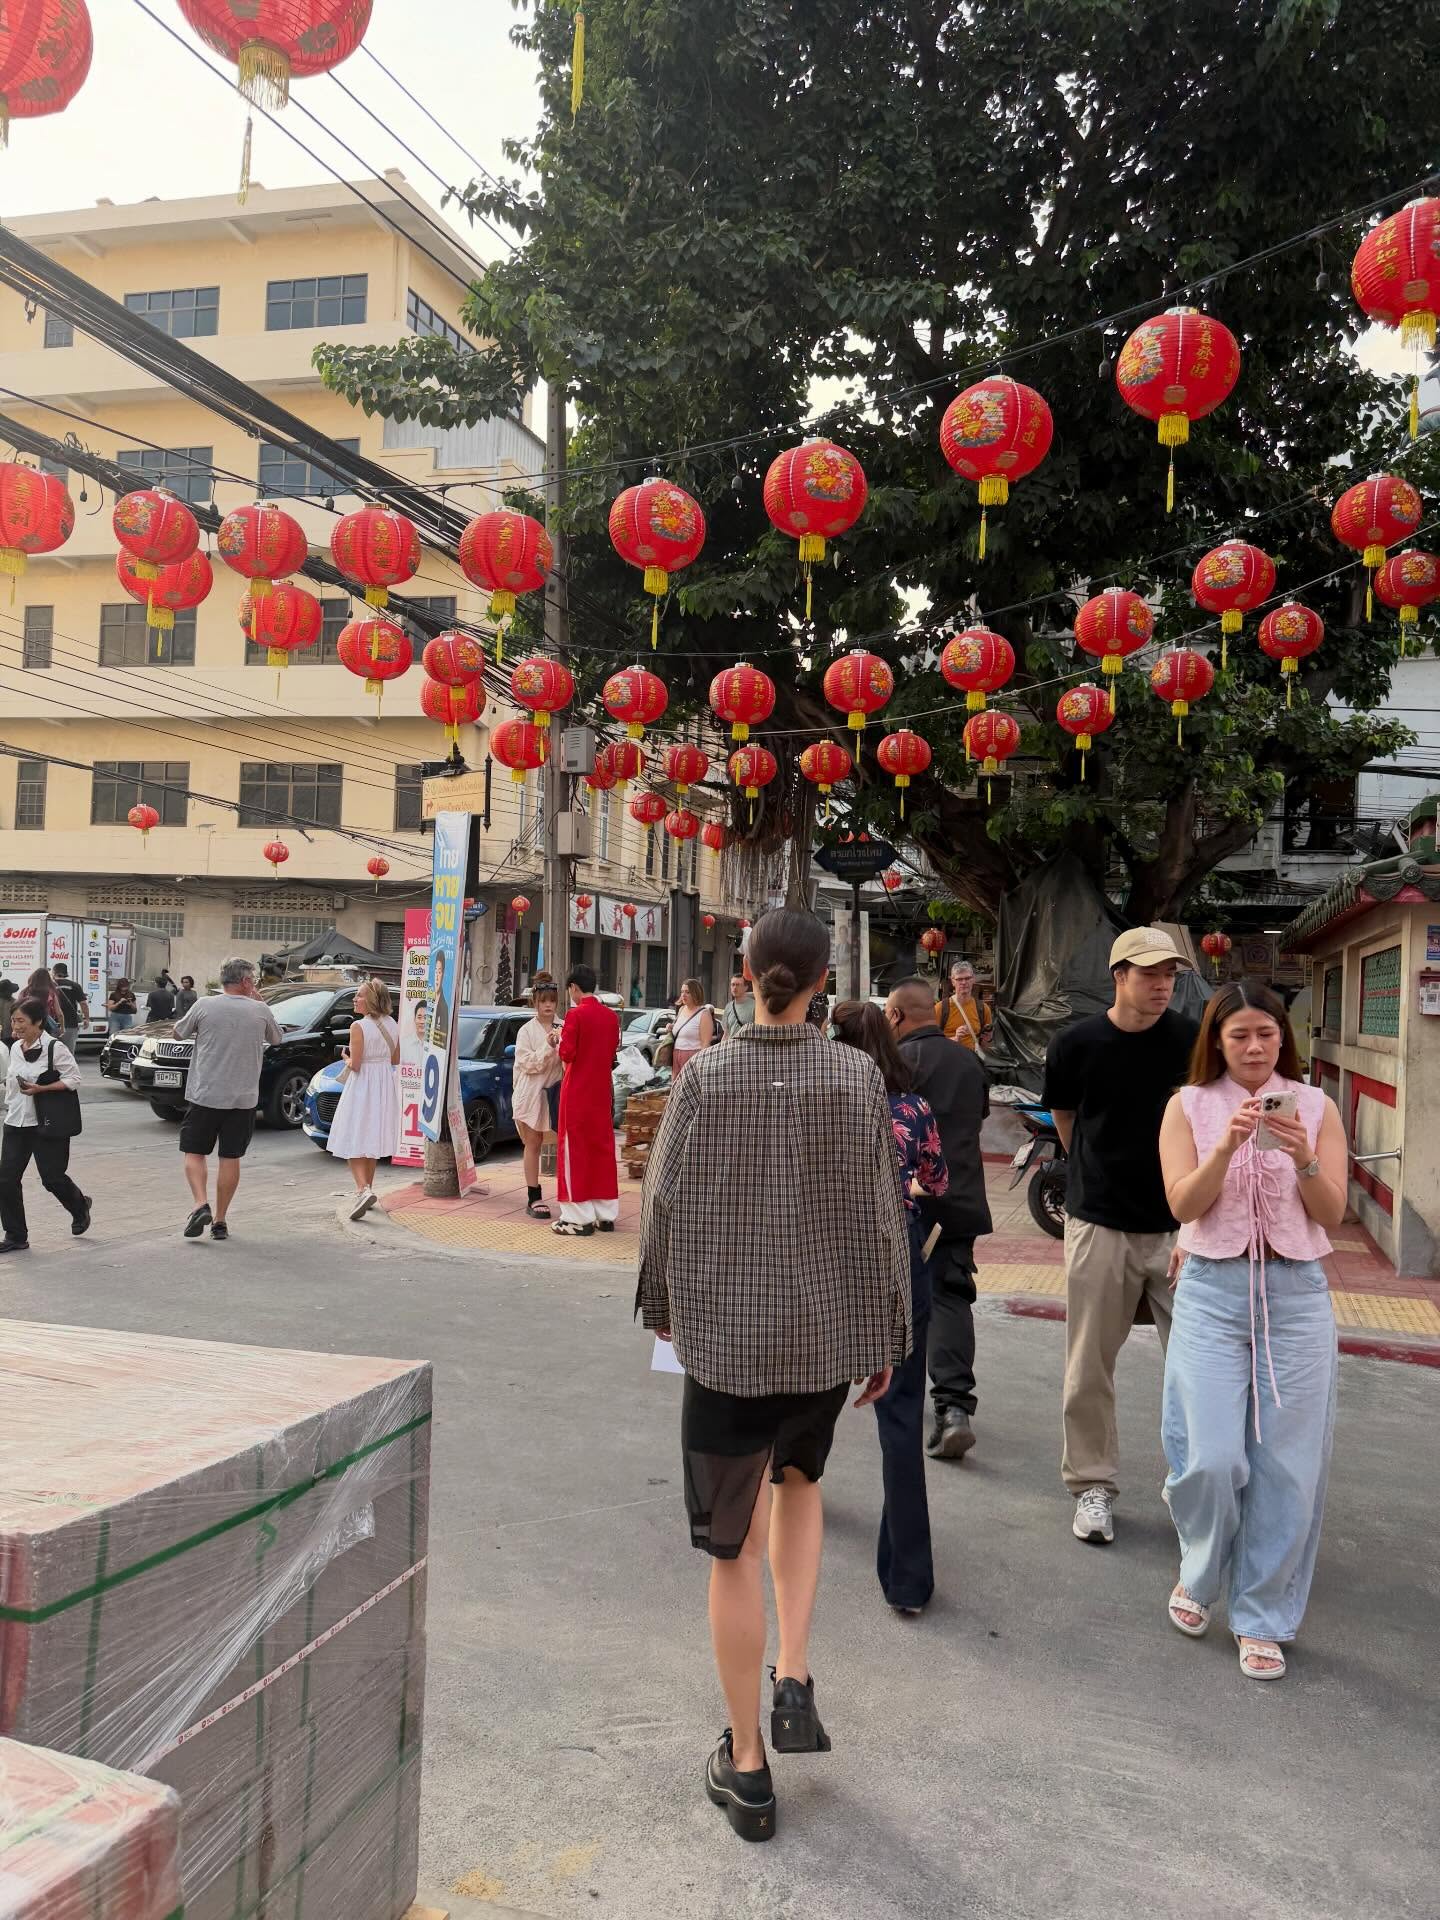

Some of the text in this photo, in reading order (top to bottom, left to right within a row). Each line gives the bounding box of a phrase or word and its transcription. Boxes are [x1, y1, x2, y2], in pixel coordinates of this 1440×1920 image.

[3, 927, 38, 939] Solid
[50, 951, 69, 960] Solid
[422, 1054, 439, 1123] 9
[404, 1103, 424, 1137] 1
